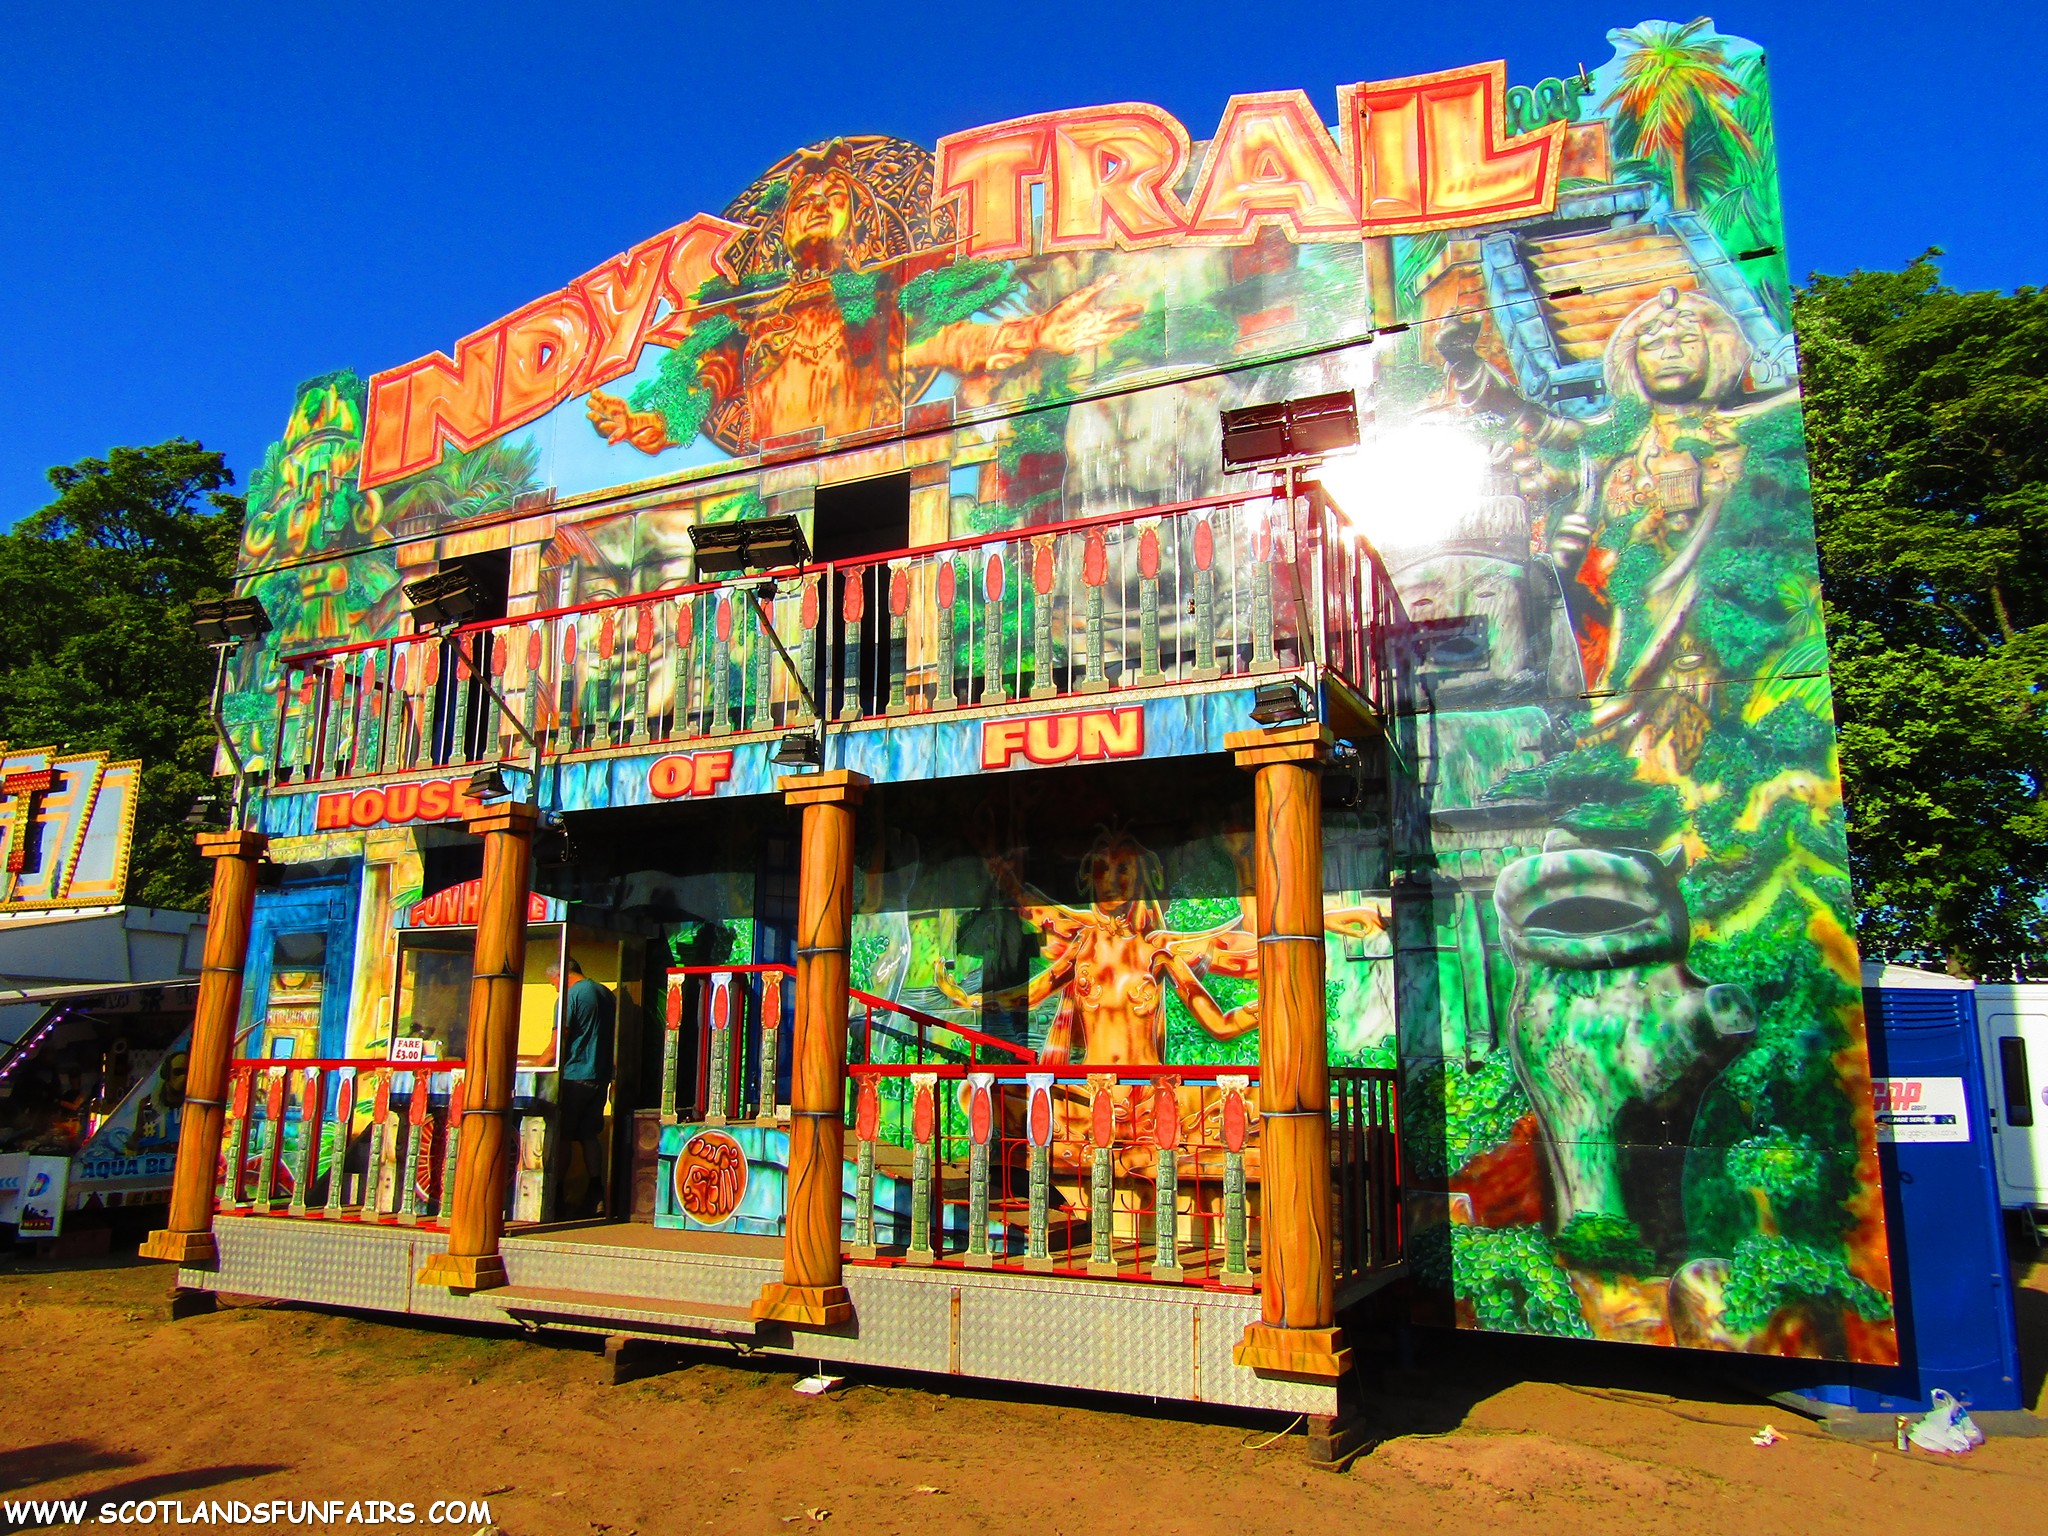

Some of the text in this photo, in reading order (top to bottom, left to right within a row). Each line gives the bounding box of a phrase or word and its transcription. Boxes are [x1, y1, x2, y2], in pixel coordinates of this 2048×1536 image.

[935, 61, 1564, 256] TRAIL
[648, 750, 733, 799] OF
[981, 704, 1143, 769] FUN
[397, 1040, 420, 1049] FARE
[395, 1049, 419, 1060] £3.00
[80, 1159, 138, 1178] AQUA
